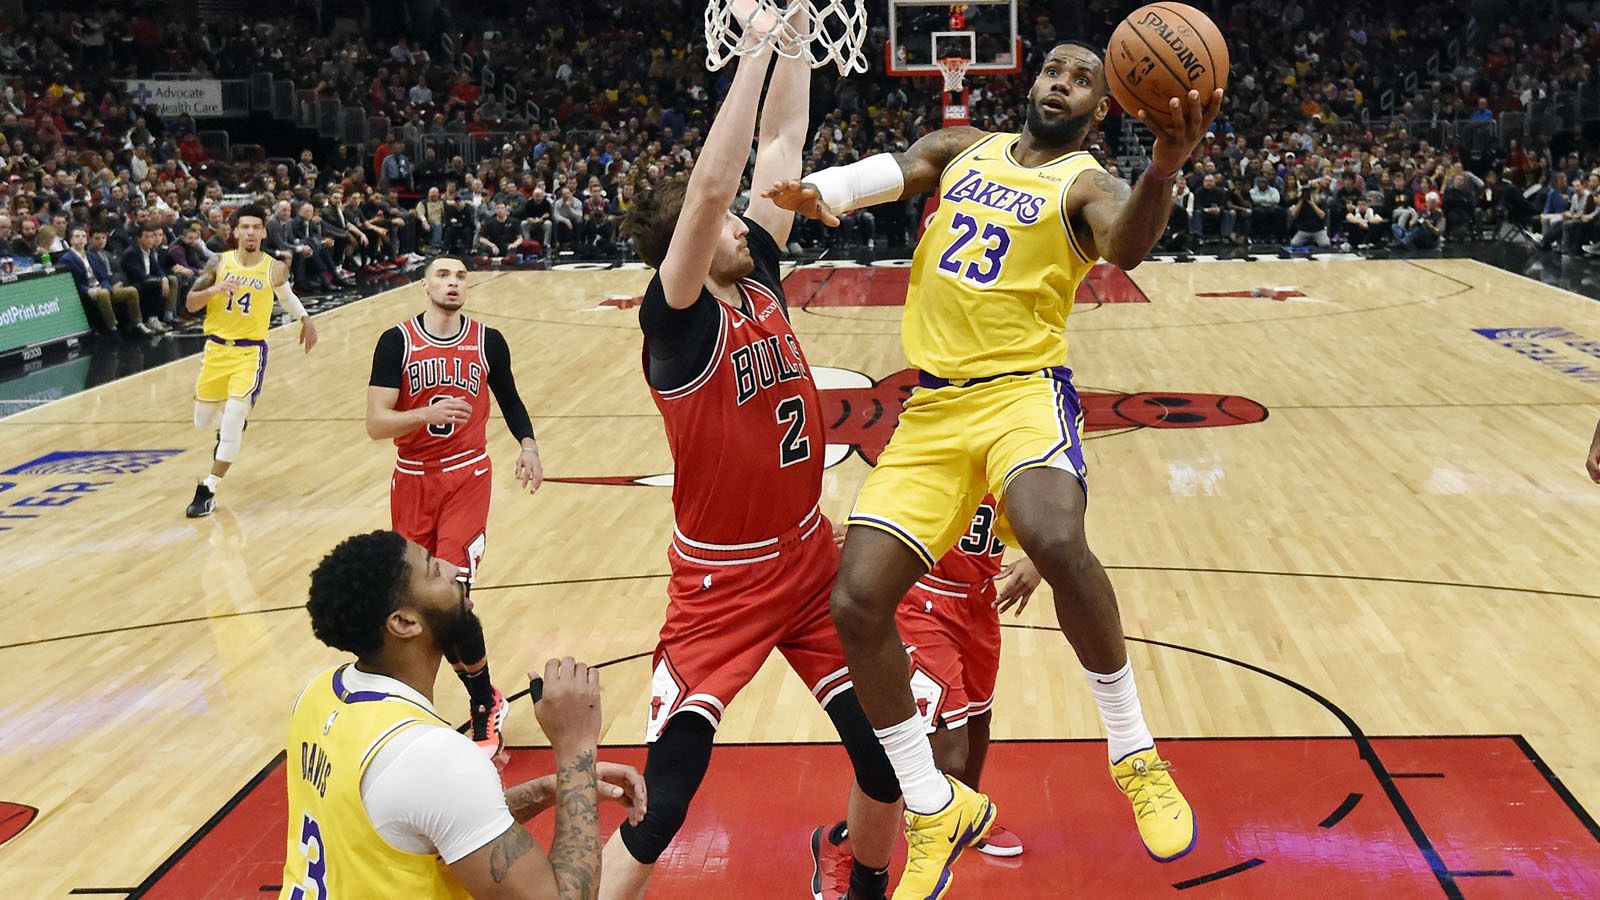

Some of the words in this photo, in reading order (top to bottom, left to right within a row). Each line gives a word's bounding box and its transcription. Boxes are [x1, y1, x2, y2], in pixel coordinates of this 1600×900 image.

[1137, 11, 1206, 84] SPALDING
[156, 87, 206, 99] Advocate
[194, 103, 218, 114] Care
[942, 168, 1047, 226] LAKERS
[936, 211, 1012, 287] 23
[225, 290, 252, 315] 14
[407, 357, 481, 397] BULLS
[731, 333, 809, 406] BUL
[775, 394, 811, 468] 2
[302, 741, 332, 799] DAVIS
[289, 812, 328, 900] 3
